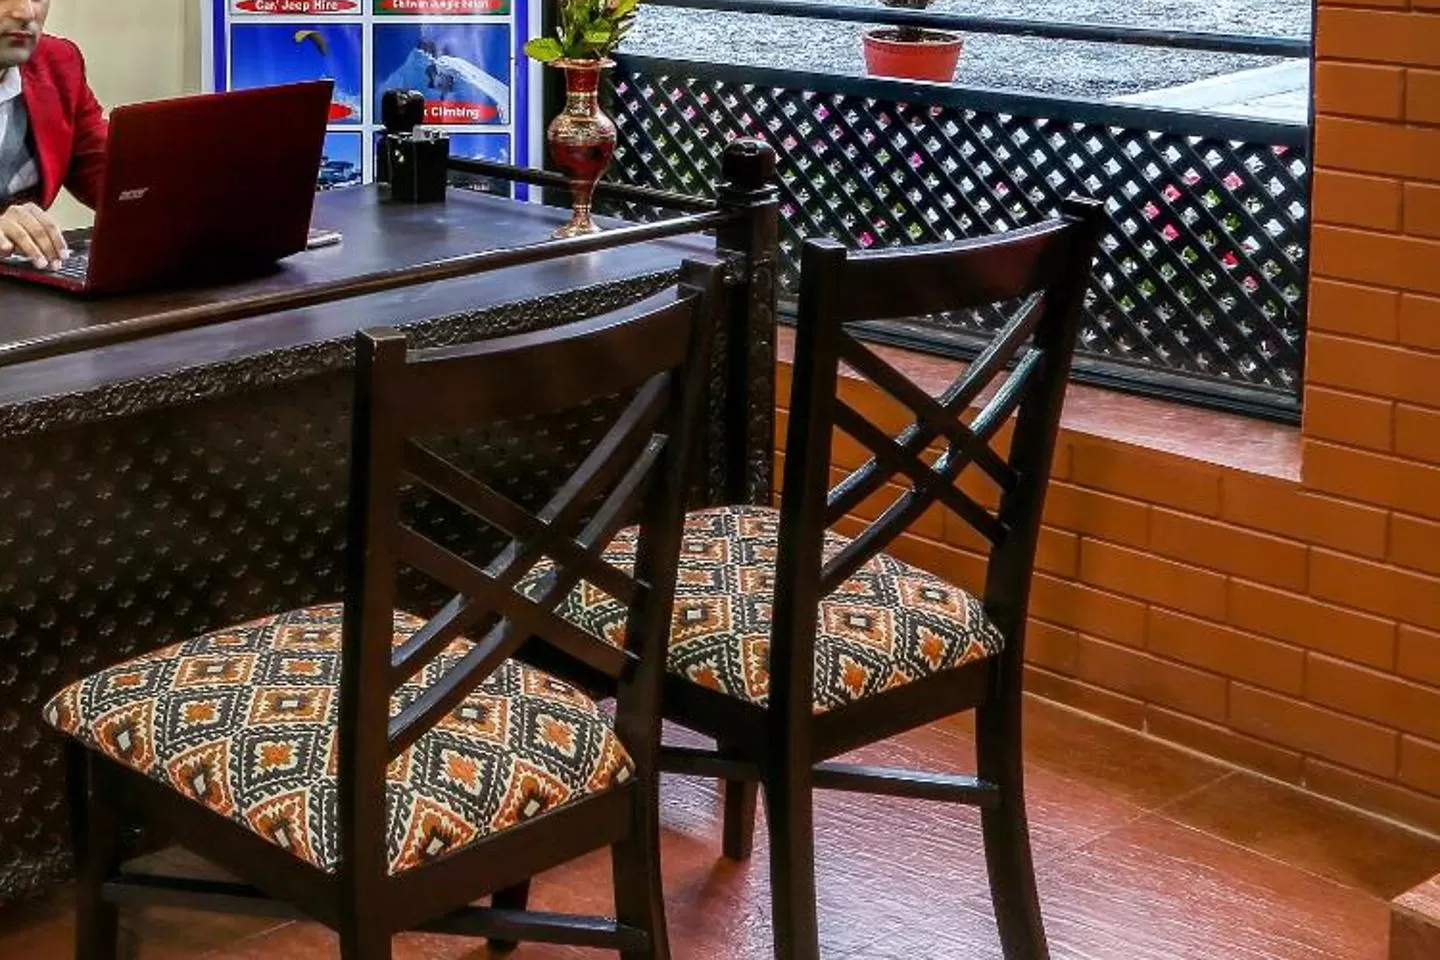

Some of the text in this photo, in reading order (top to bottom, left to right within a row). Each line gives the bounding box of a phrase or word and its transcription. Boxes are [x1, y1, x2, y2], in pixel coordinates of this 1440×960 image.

[281, 0, 310, 12] Jeep
[313, 0, 338, 11] Hire
[431, 106, 480, 120] Climbing
